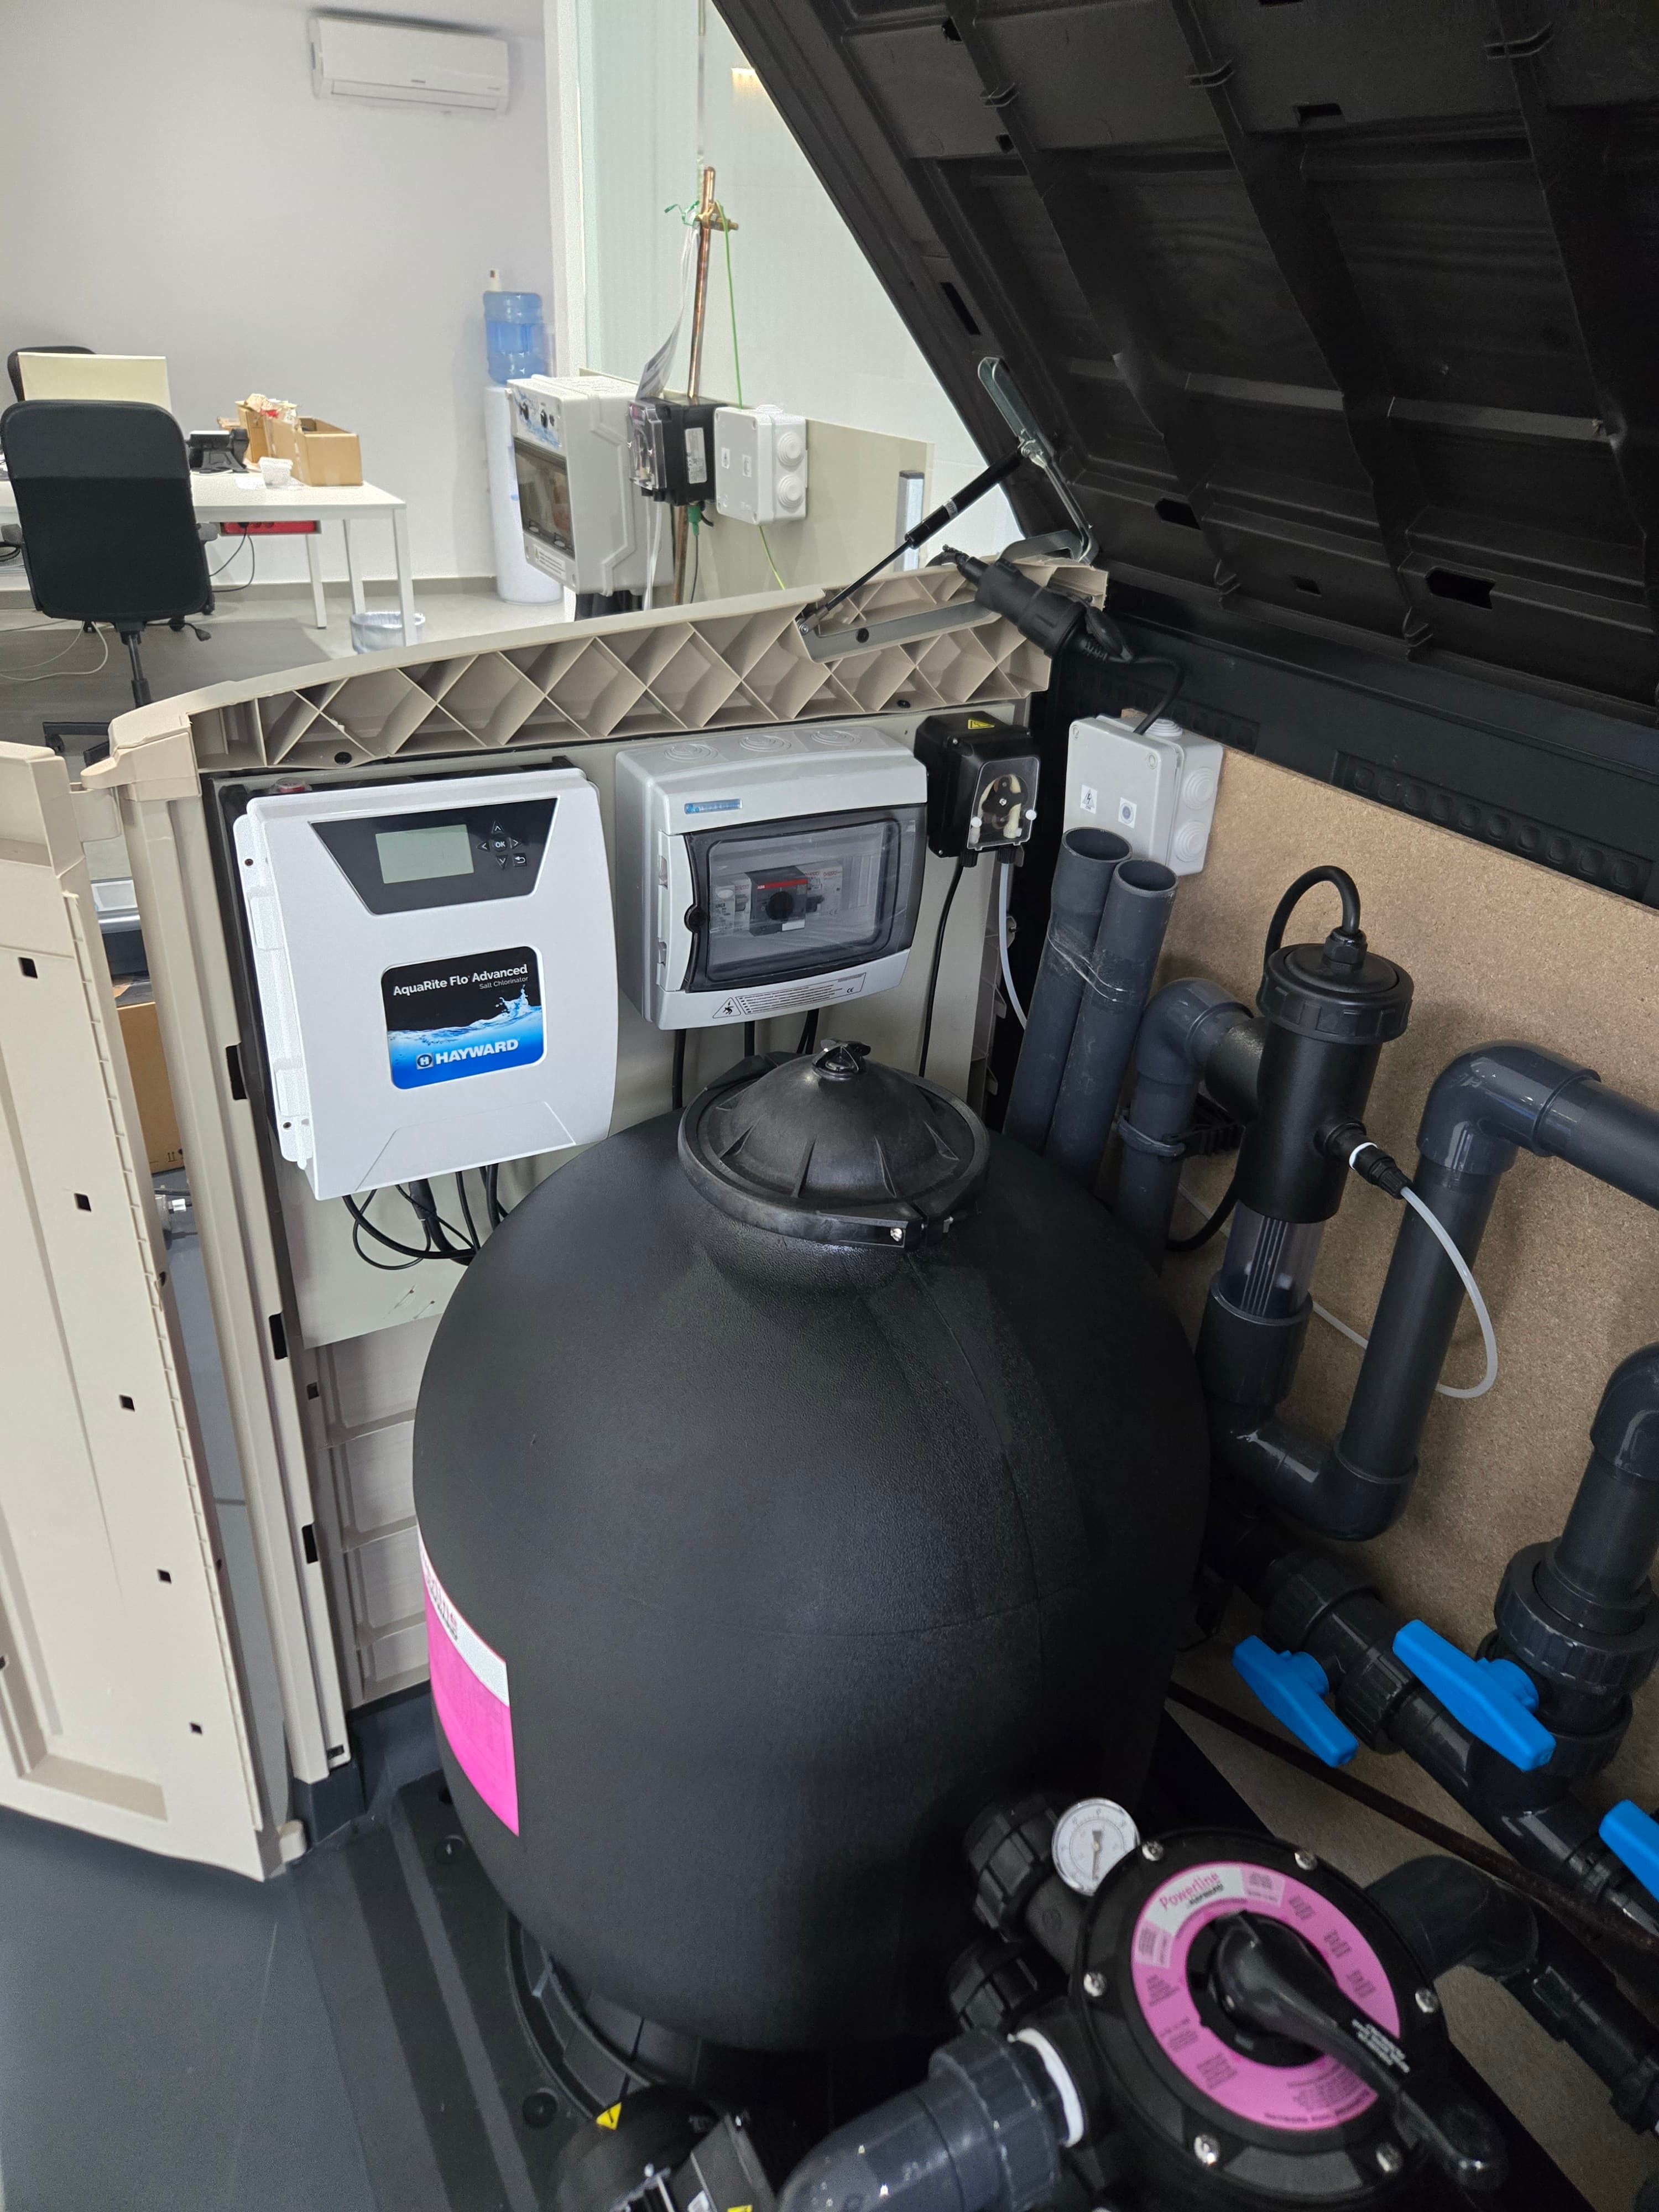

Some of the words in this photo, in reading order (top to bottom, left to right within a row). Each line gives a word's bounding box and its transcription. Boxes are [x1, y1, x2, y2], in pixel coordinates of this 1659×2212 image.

[393, 979, 447, 996] AquaRite
[450, 975, 468, 987] Flo
[472, 964, 528, 983] Advanced
[493, 977, 529, 988] Chlorinator
[436, 1039, 519, 1065] HAYWARD
[1159, 1872, 1219, 1912] Powerline
